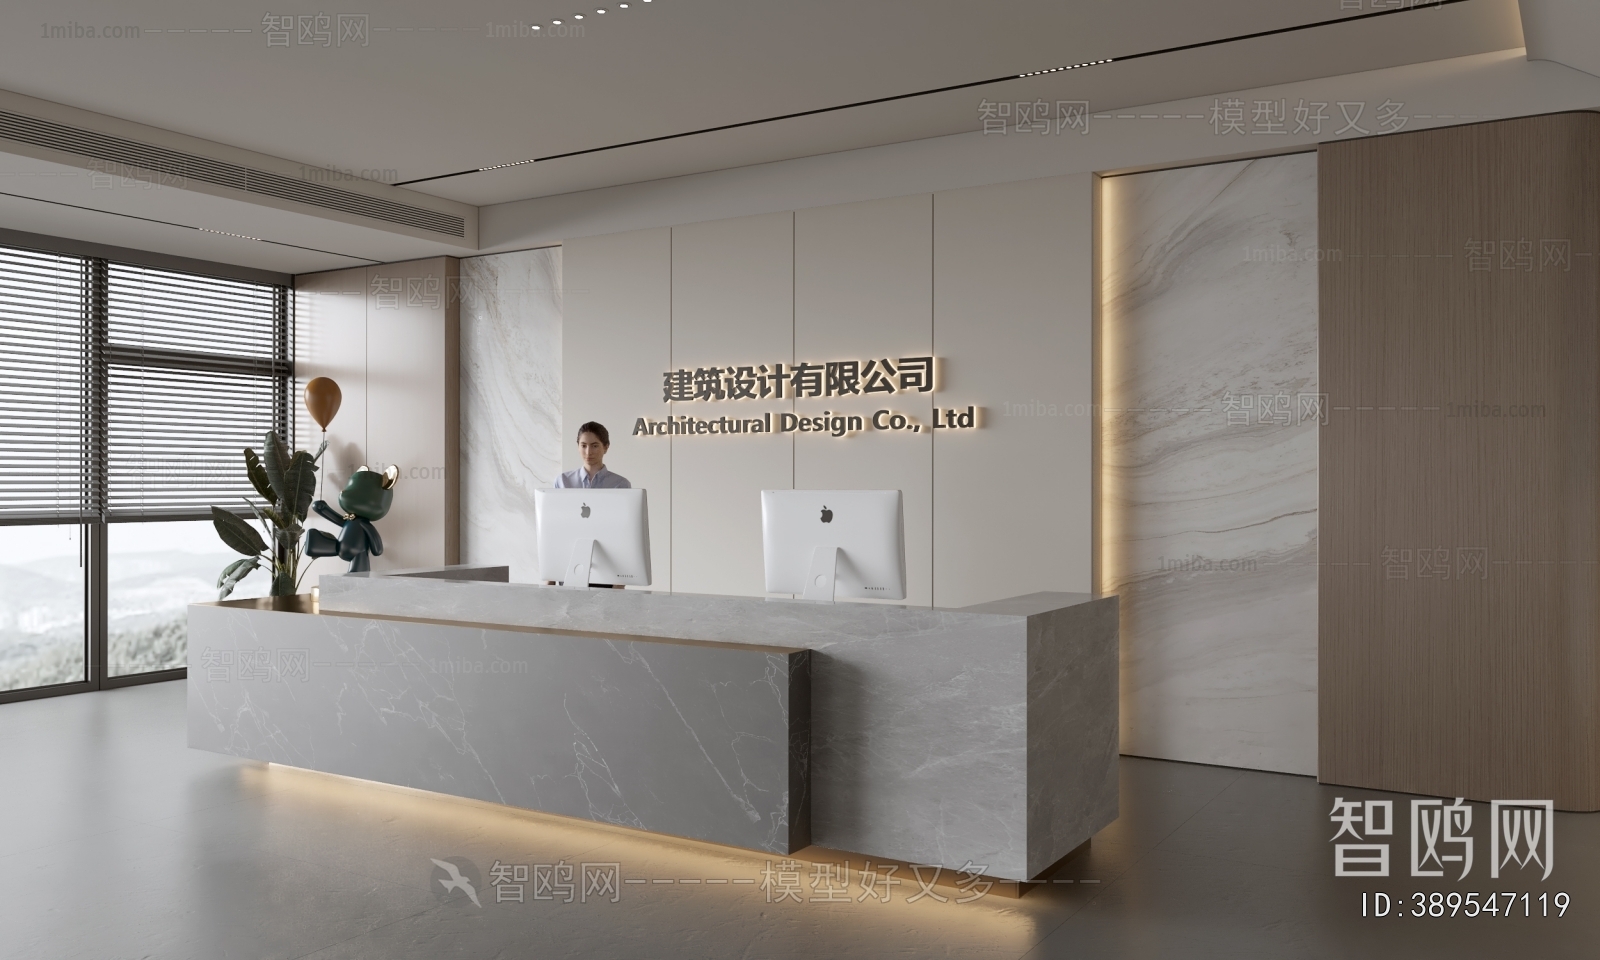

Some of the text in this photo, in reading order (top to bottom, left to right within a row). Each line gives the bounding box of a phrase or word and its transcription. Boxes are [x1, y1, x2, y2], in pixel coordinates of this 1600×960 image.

[662, 356, 935, 403] 建筑设计有限公司
[632, 406, 976, 437] Architectural Design Co., Ltd
